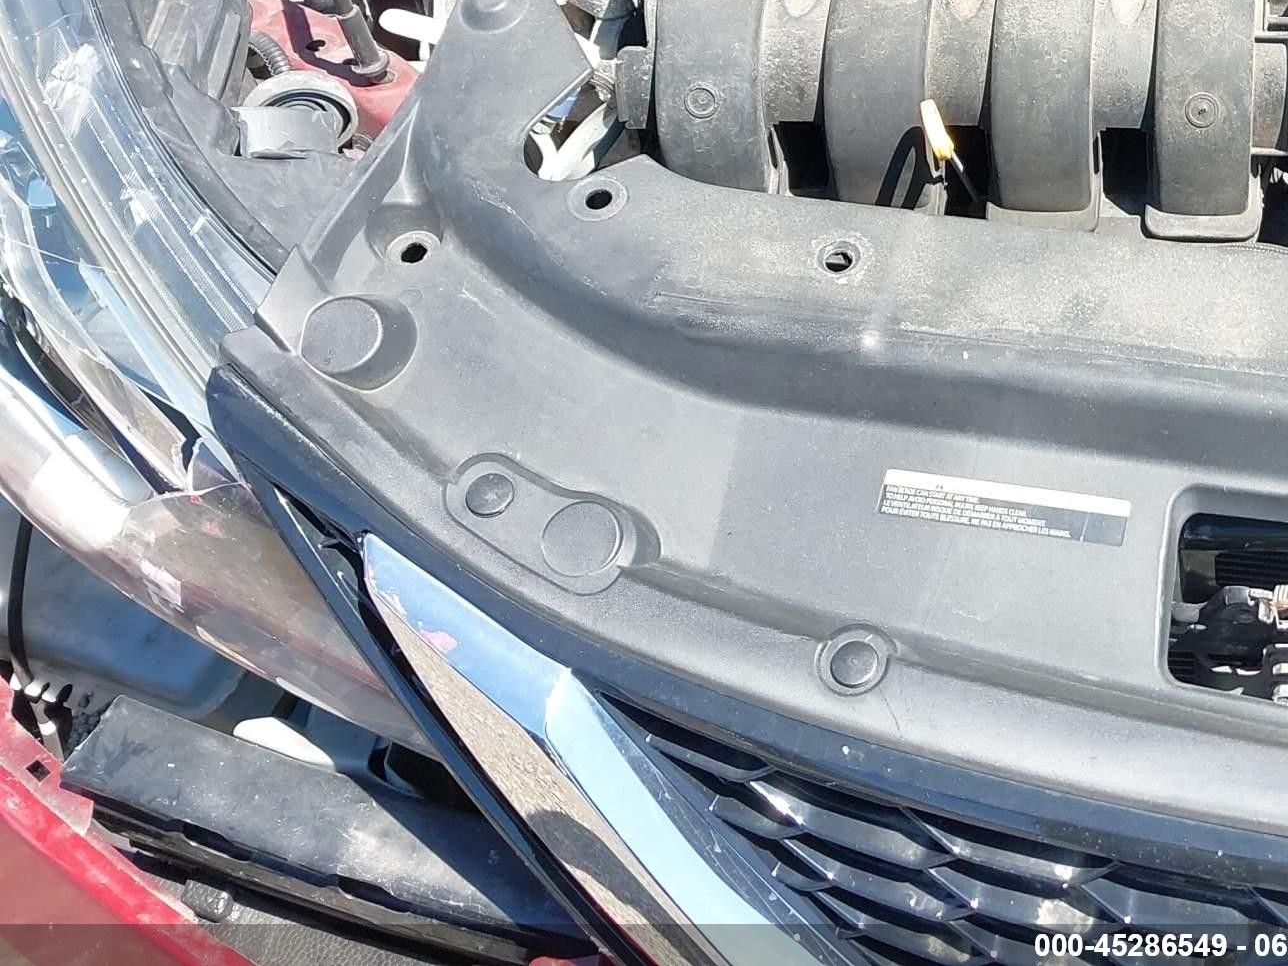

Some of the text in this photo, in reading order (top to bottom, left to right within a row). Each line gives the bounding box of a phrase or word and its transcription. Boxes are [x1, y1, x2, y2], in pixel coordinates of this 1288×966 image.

[891, 500, 929, 511] VENTILATEUR
[1001, 514, 1017, 522] TOUT
[893, 493, 907, 501] HELP
[908, 495, 925, 503] AVOID
[926, 497, 952, 507] PERSONAL
[988, 505, 1008, 514] HANDS
[881, 506, 898, 514] POUR
[919, 511, 939, 520] TOUTE
[1038, 526, 1048, 534] LES
